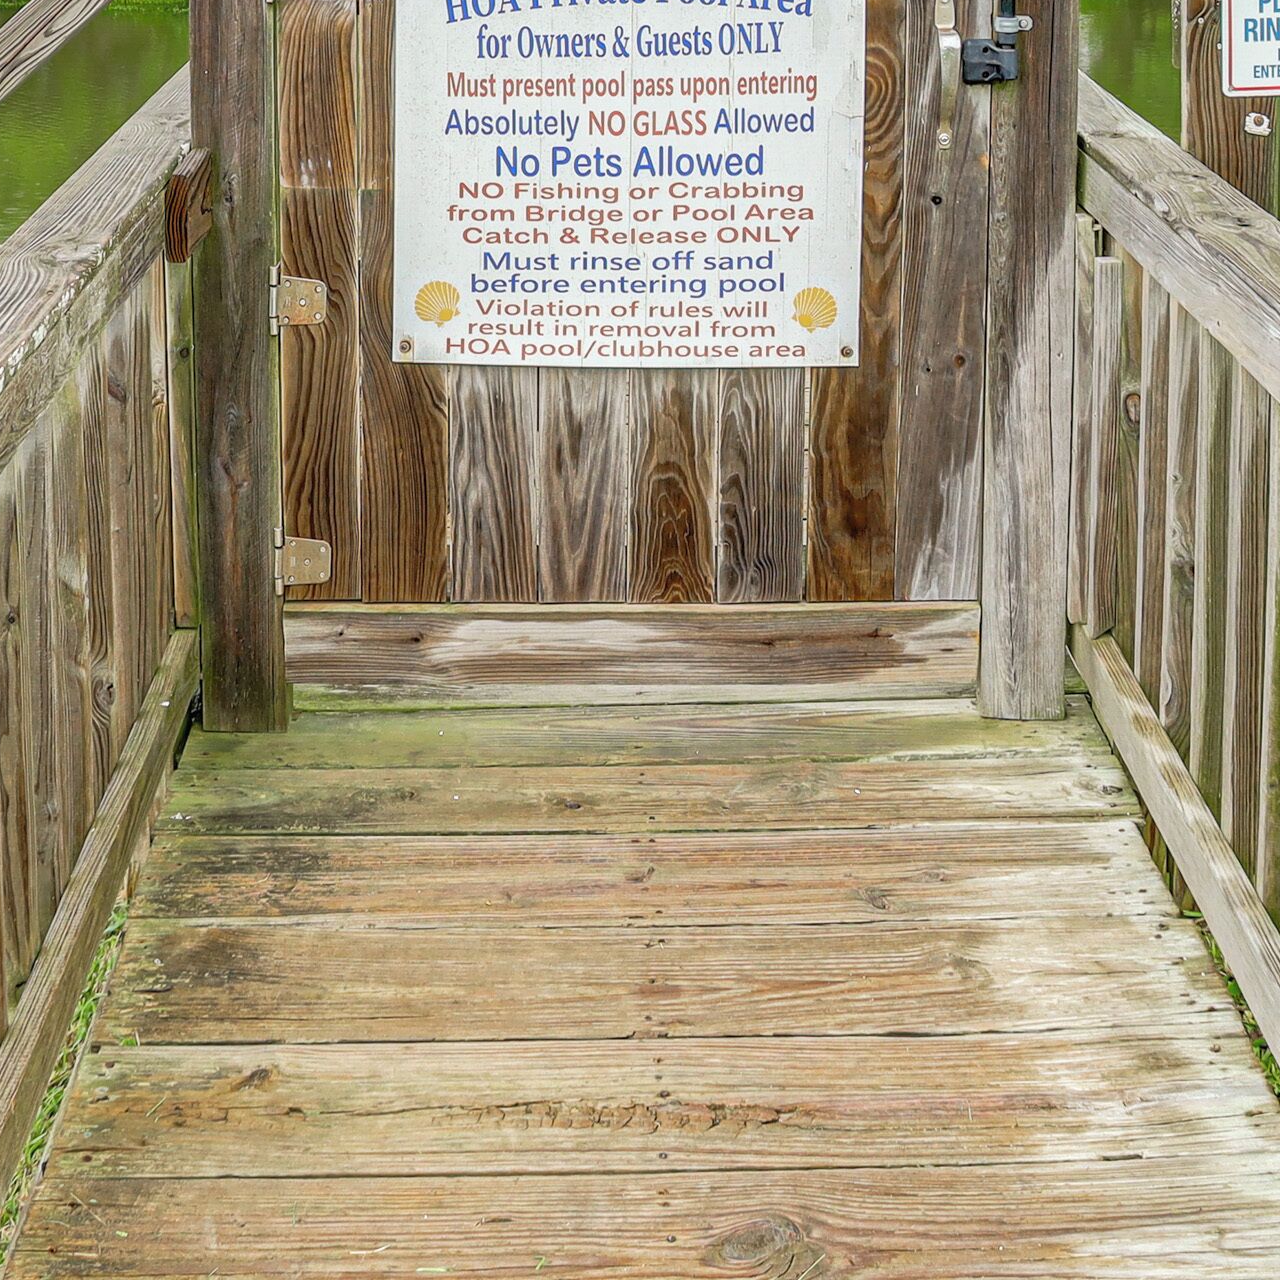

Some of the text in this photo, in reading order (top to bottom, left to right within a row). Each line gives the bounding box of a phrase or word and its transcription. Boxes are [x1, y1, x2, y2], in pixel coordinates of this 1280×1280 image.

[477, 22, 784, 59] for Owners & Guests ONLY
[448, 68, 817, 105] Must present pool pass upon entering
[445, 106, 814, 142] Absolutely NO GLASS Allowed
[496, 145, 763, 177] No Pets Allowed
[459, 182, 803, 203] NO Fishing or Crabbing
[447, 204, 814, 226] from Bridge or Pool Area
[463, 226, 800, 244] Catch & Release ONLY
[484, 250, 773, 271] Must rinse off sand
[471, 273, 784, 298] before entering pool
[476, 299, 767, 317] Violation of rules will
[469, 319, 775, 337] result in removal from
[446, 338, 805, 360] HOA pool/clubhouse area
